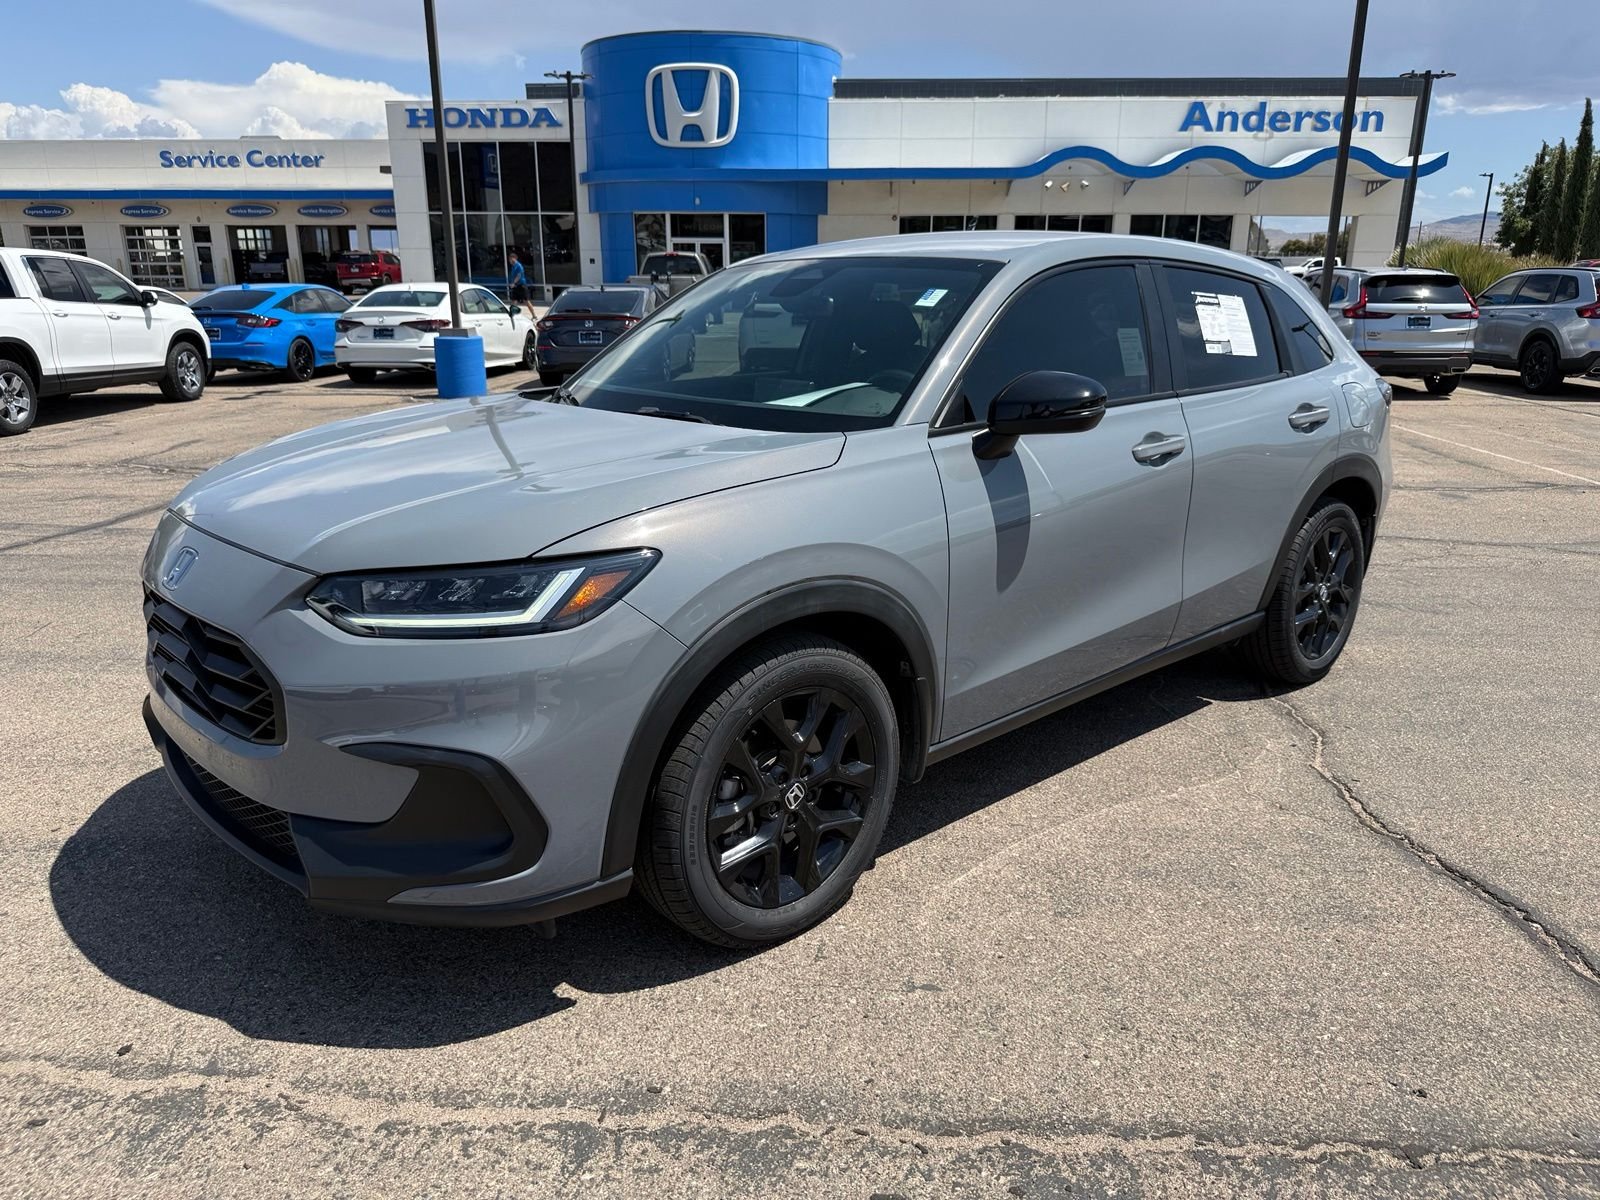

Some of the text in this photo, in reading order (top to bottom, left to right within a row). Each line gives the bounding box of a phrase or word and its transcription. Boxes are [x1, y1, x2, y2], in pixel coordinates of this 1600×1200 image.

[405, 107, 562, 128] HONDA
[1178, 101, 1384, 132] Anderson
[159, 149, 325, 168] Service Center
